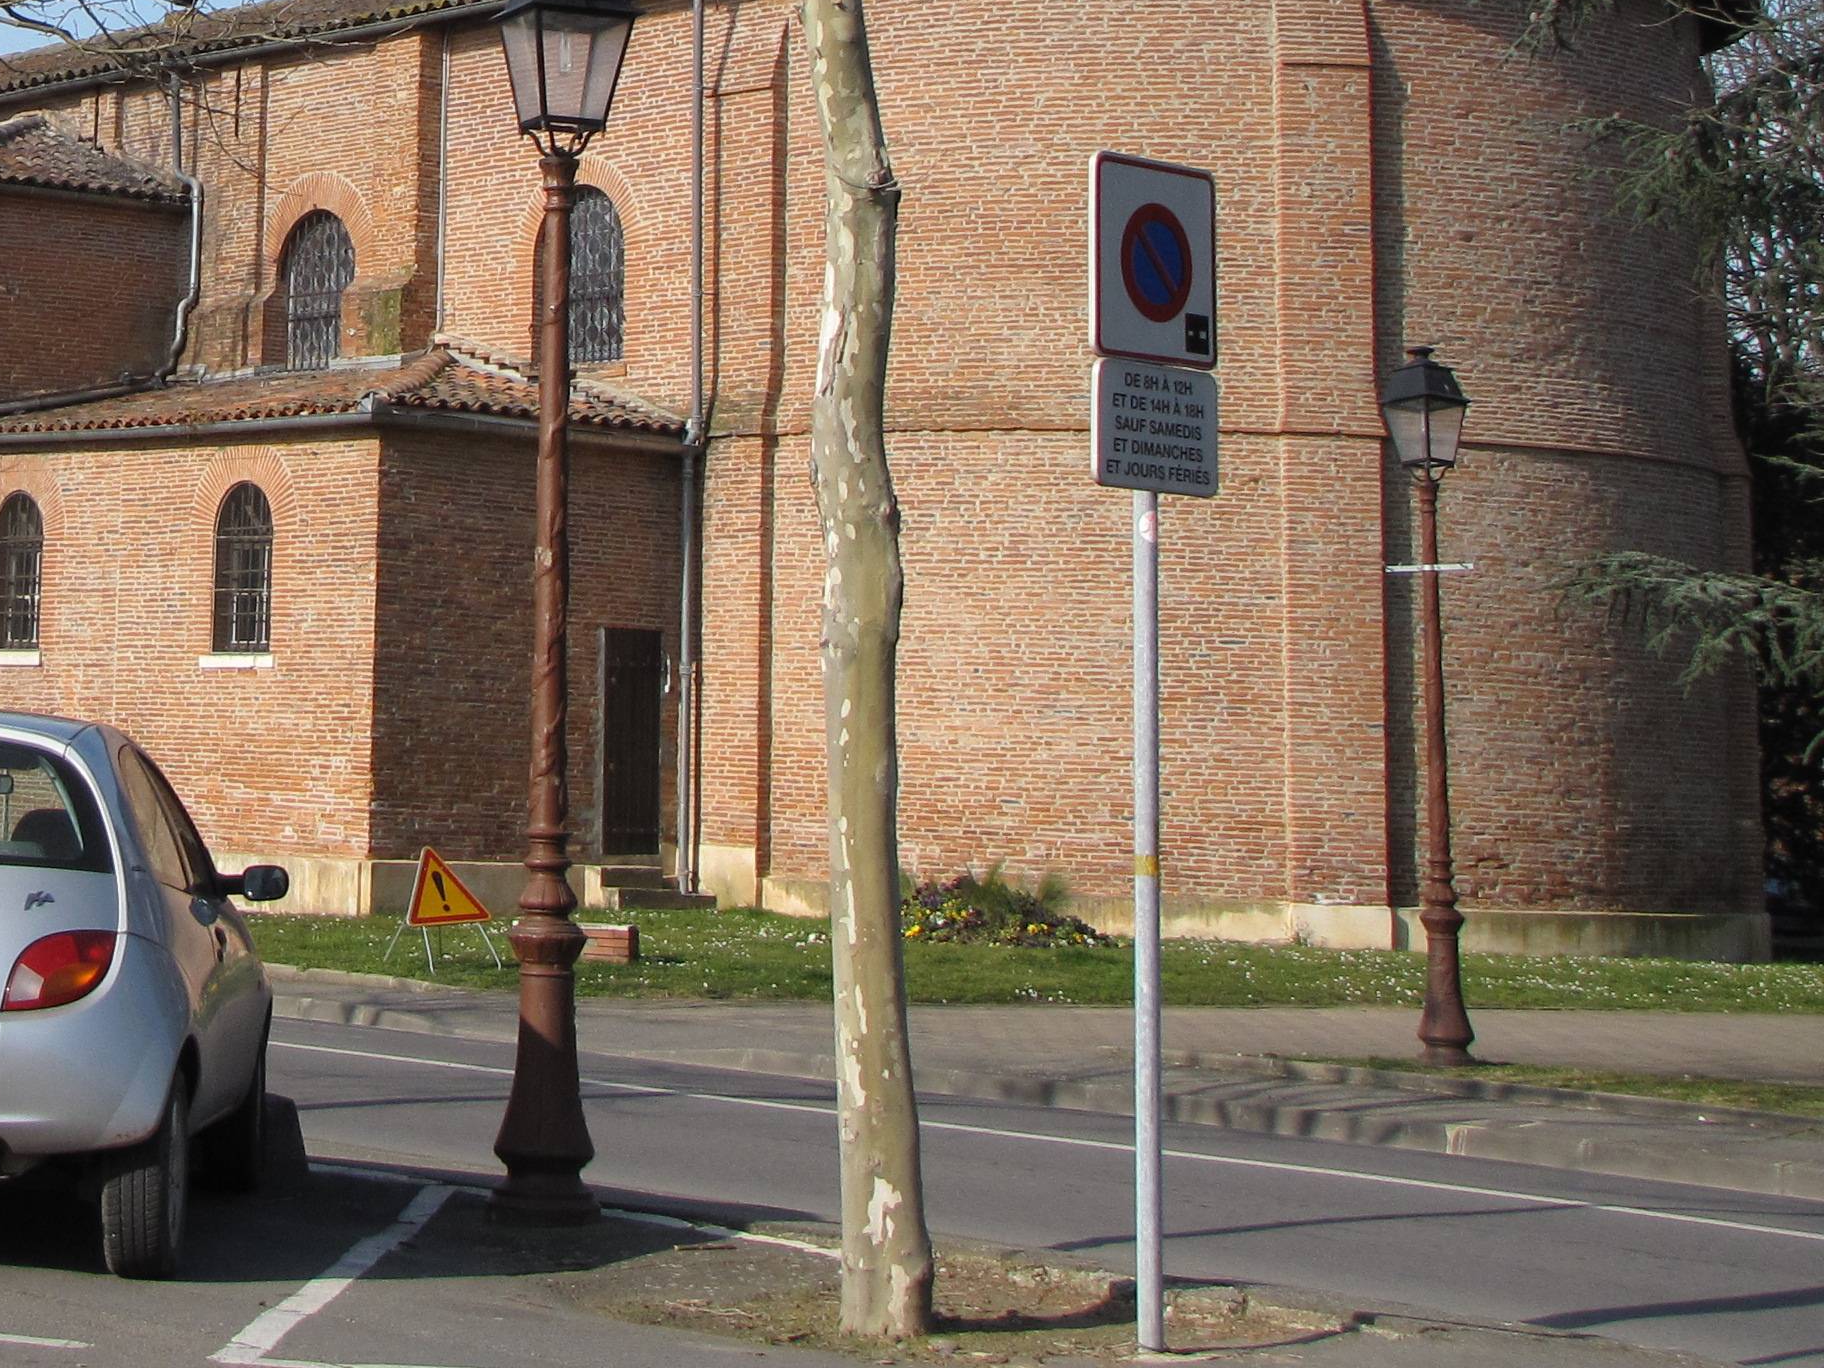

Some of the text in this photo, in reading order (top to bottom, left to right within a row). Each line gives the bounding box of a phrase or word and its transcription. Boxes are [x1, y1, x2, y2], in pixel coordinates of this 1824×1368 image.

[1124, 372, 1193, 395] DE 8H À 12H
[1112, 393, 1204, 419] ET DE 14H À 18H
[1115, 416, 1202, 440] SAUF SAMEDIS
[1113, 438, 1203, 463] ET DIMANCHES
[1106, 459, 1210, 485] ET JOURS FÉRIÉS
